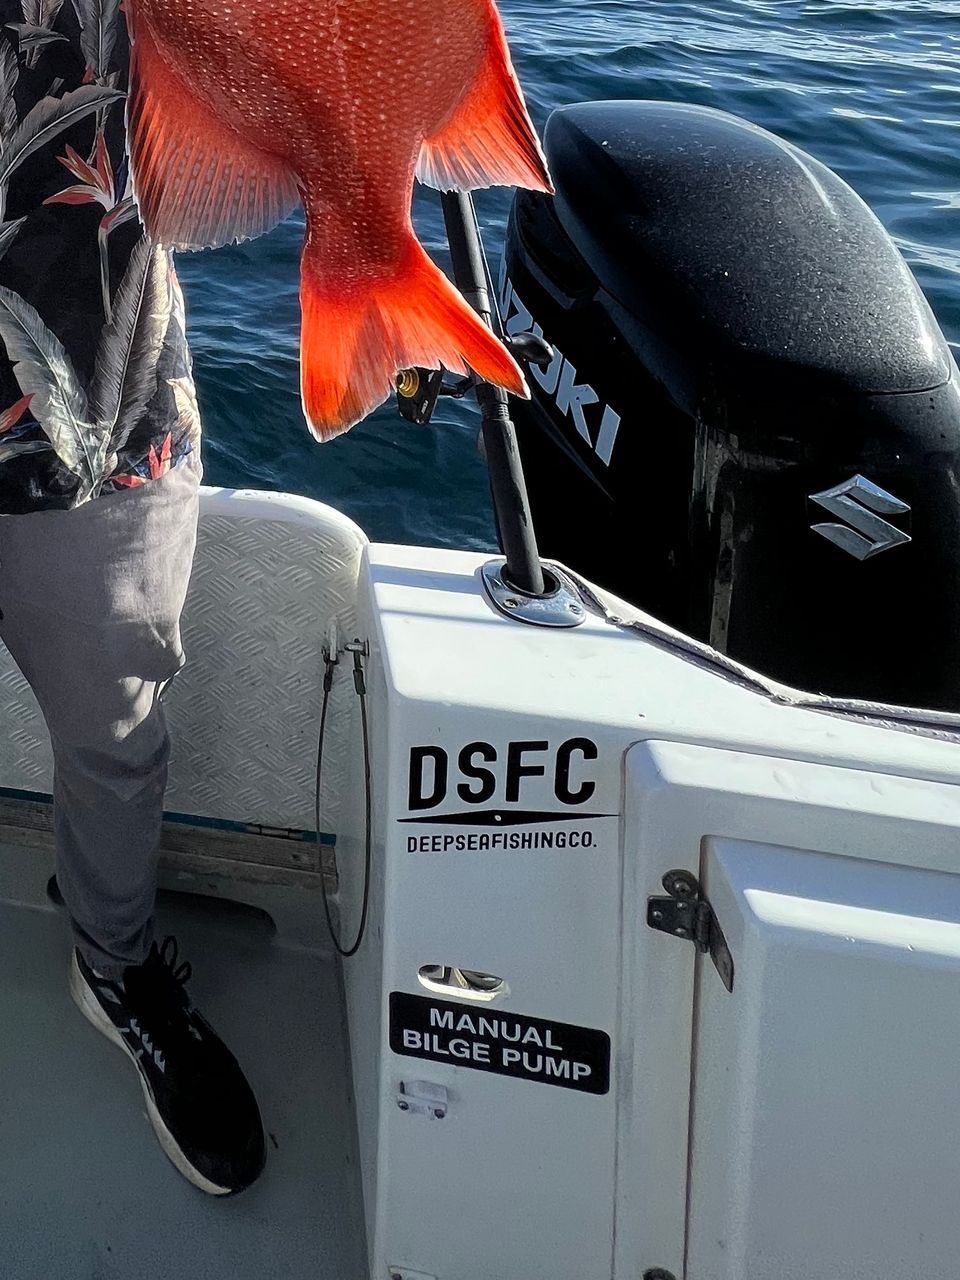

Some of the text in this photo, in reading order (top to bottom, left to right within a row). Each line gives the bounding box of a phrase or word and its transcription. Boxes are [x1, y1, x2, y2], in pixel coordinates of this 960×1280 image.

[498, 240, 621, 467] UZUKI
[408, 737, 598, 811] DSFC
[407, 830, 597, 853] DEEPSEAFISHINGCO.
[403, 1028, 592, 1081] BILGE PUMP
[429, 1007, 563, 1051] MANUAL
